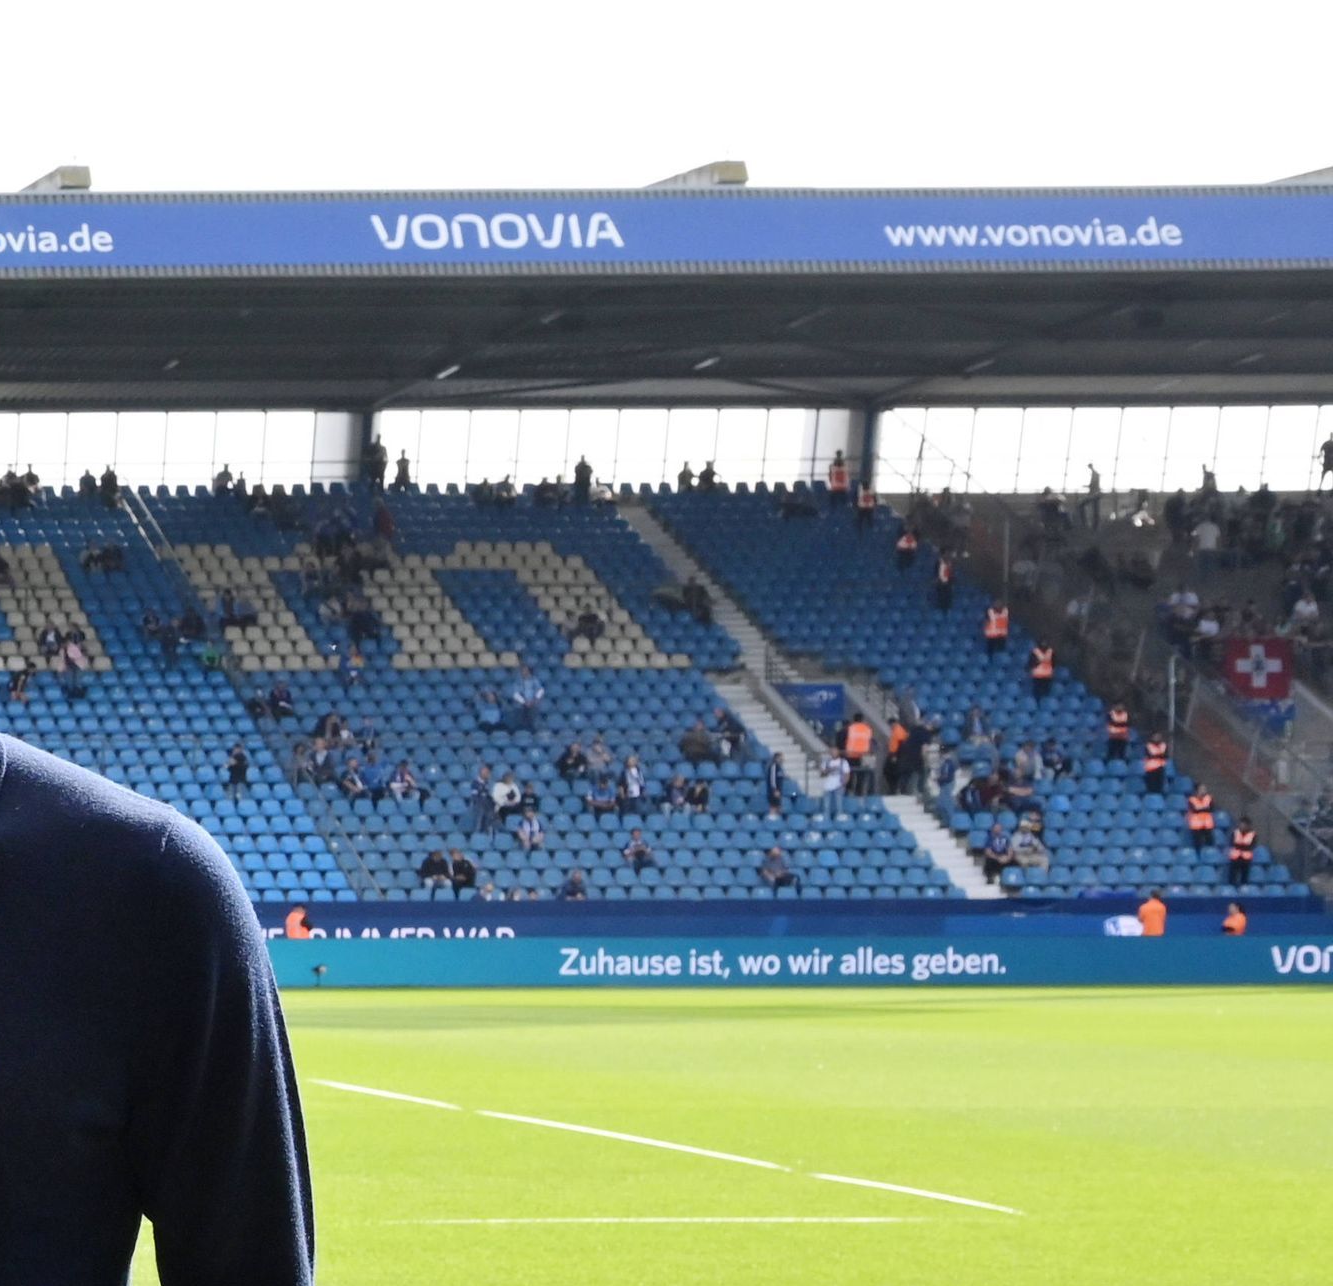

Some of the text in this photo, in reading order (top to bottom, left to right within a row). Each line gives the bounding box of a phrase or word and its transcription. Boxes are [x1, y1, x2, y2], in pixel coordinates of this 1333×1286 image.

[370, 212, 625, 250] VONOVIA
[884, 216, 1183, 248] www.vonovia.de
[559, 946, 1007, 980] Zuhause ist, wo wir alles geben.
